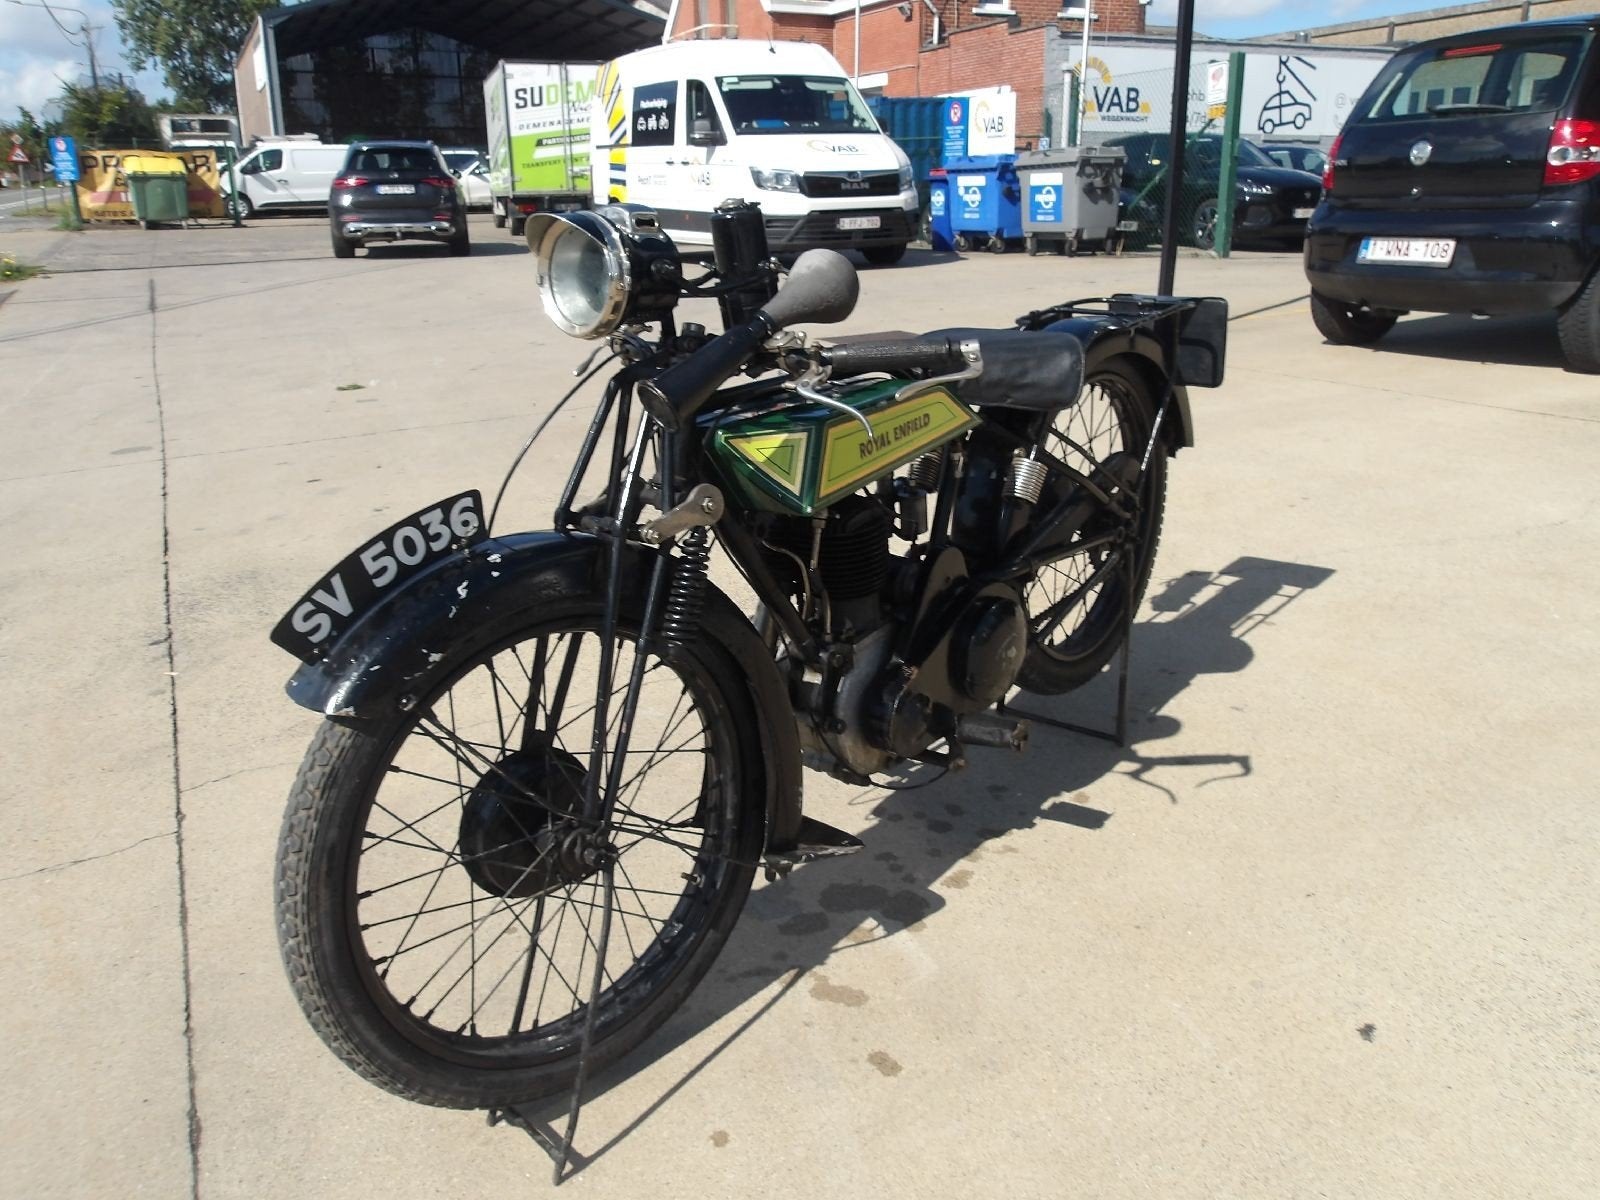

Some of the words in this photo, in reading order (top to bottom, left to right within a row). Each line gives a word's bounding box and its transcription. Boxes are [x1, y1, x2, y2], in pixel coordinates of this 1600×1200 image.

[1093, 86, 1140, 113] VAB
[983, 116, 1004, 133] VAB
[824, 145, 859, 153] VAB
[1370, 240, 1451, 258] 1-WNA-108
[859, 431, 891, 459] ROYAL
[893, 413, 930, 441] ENFIELD
[291, 572, 354, 644] SV
[359, 497, 479, 588] 5036
